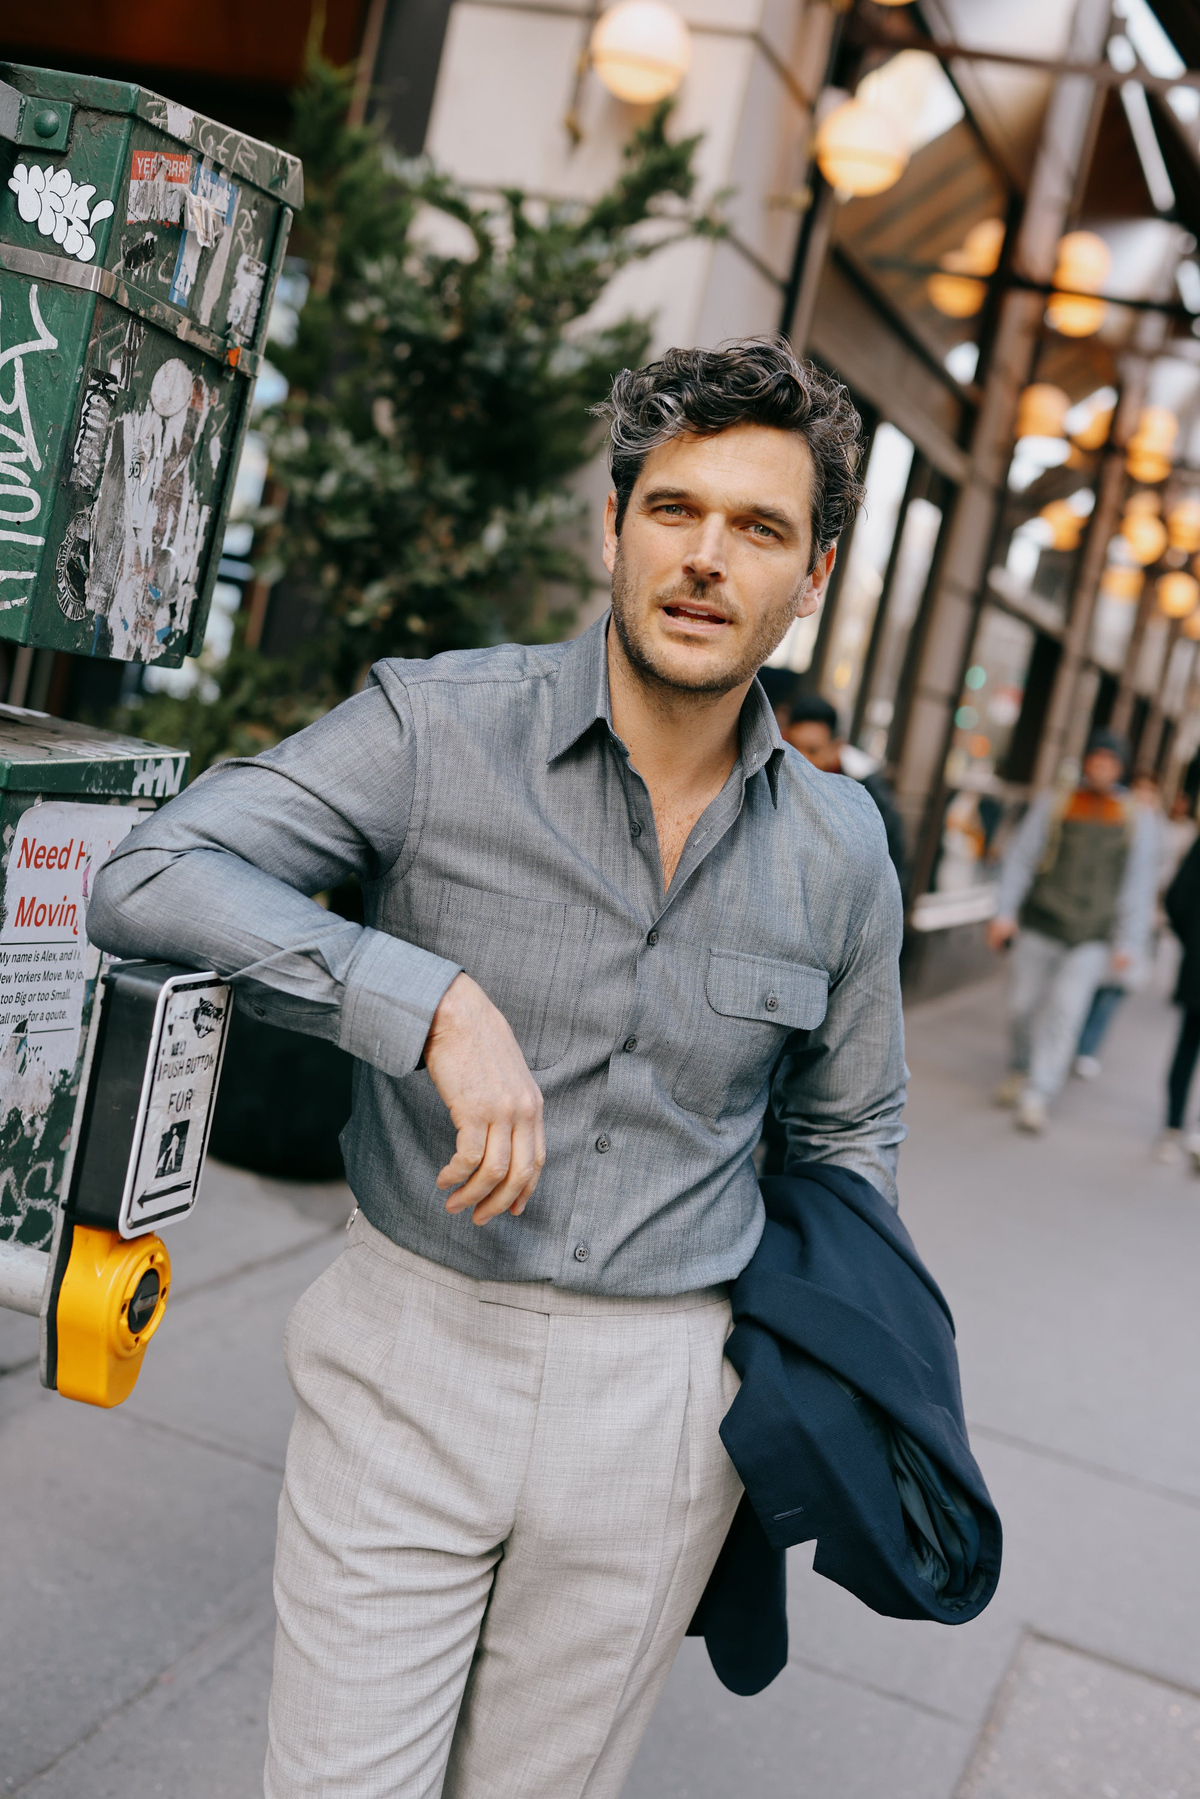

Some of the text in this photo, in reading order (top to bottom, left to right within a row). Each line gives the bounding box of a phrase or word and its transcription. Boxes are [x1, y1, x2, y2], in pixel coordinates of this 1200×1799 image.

[17, 837, 74, 870] Need
[0, 952, 11, 966] My
[11, 952, 32, 963] name
[33, 950, 40, 962] is
[40, 950, 57, 964] Alex,
[59, 948, 73, 961] and
[14, 971, 41, 983] Yorkers
[42, 970, 63, 982] Move.
[64, 969, 75, 980] No
[74, 968, 84, 983] jo
[0, 988, 71, 1006] too Big or too Small.
[10, 1014, 26, 1024] now
[28, 1010, 38, 1022] for
[39, 1013, 44, 1021] a
[45, 1010, 67, 1024] qoute.
[161, 1053, 215, 1080] PUSH BUTTON
